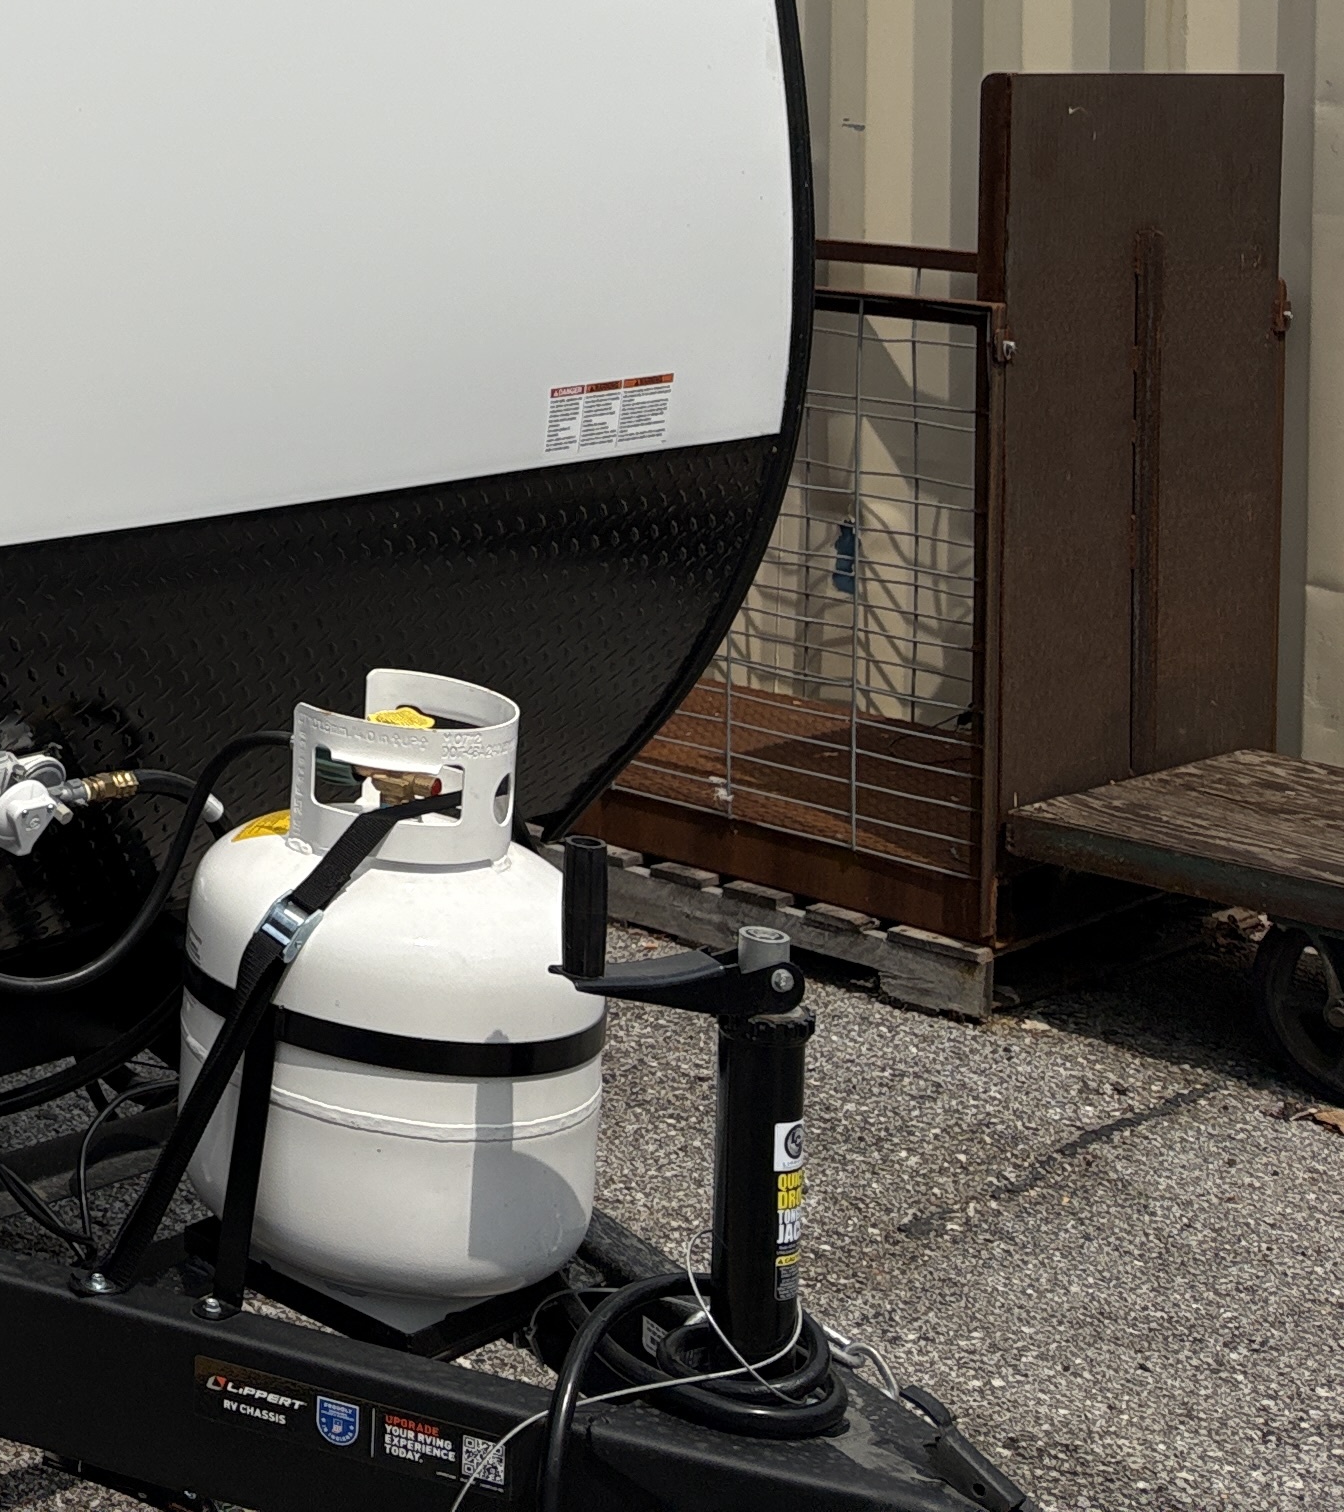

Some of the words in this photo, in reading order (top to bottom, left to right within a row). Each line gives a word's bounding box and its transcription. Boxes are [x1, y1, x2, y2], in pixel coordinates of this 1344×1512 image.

[223, 1399, 238, 1411] RV
[239, 1404, 286, 1425] CHASSIS
[384, 1414, 439, 1436] UPGRADE
[384, 1424, 415, 1440] YOUR
[417, 1433, 452, 1451] RVING
[384, 1434, 456, 1462] EXPERIENCE
[384, 1444, 424, 1463] TODAY.
